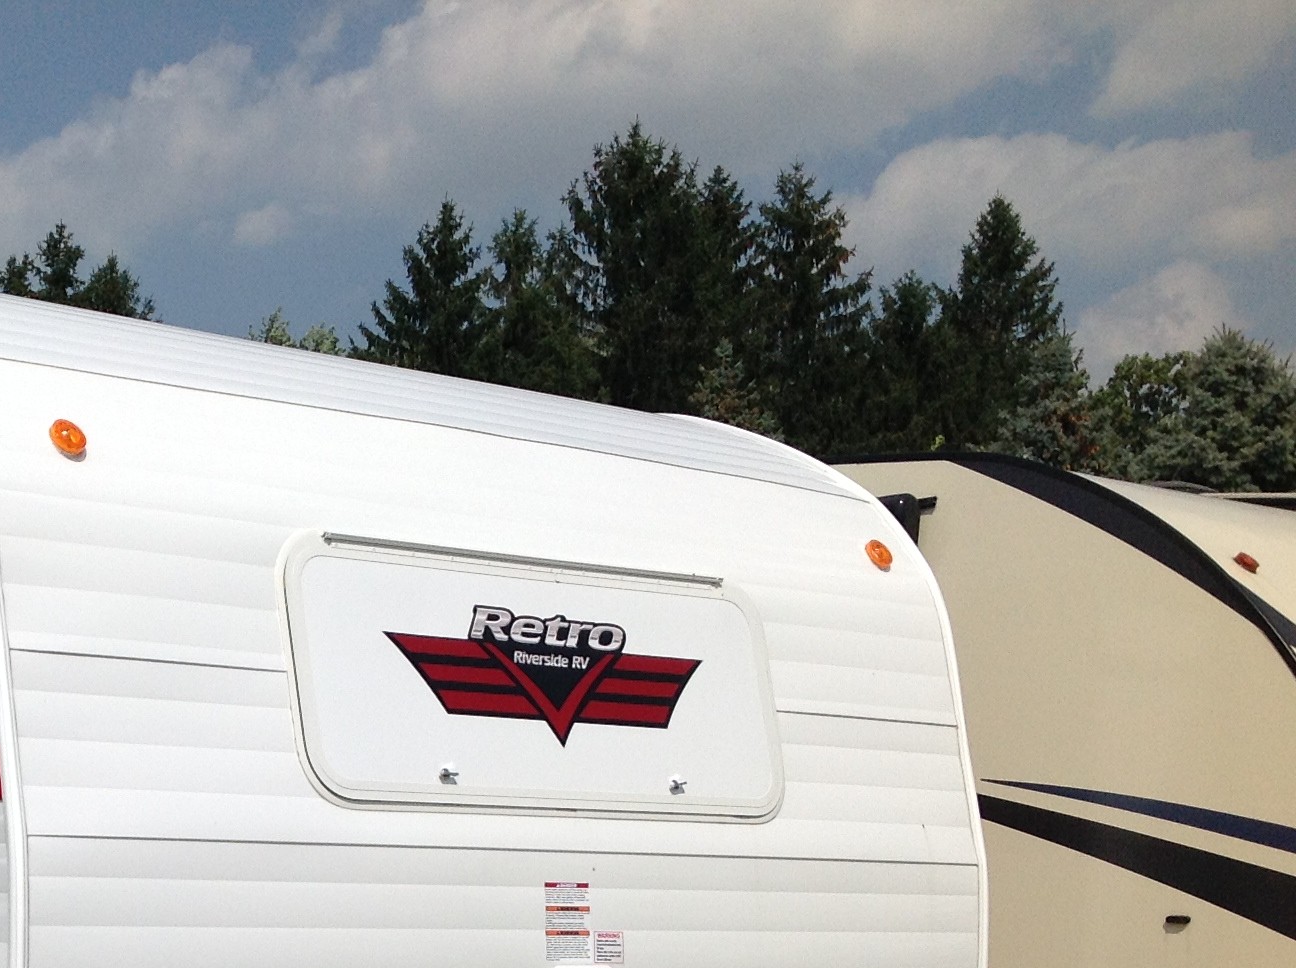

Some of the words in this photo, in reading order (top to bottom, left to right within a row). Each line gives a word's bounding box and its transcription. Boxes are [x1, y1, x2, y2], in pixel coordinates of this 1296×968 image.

[470, 606, 625, 651] Retro
[513, 650, 570, 668] Riverside
[571, 655, 590, 670] RV
